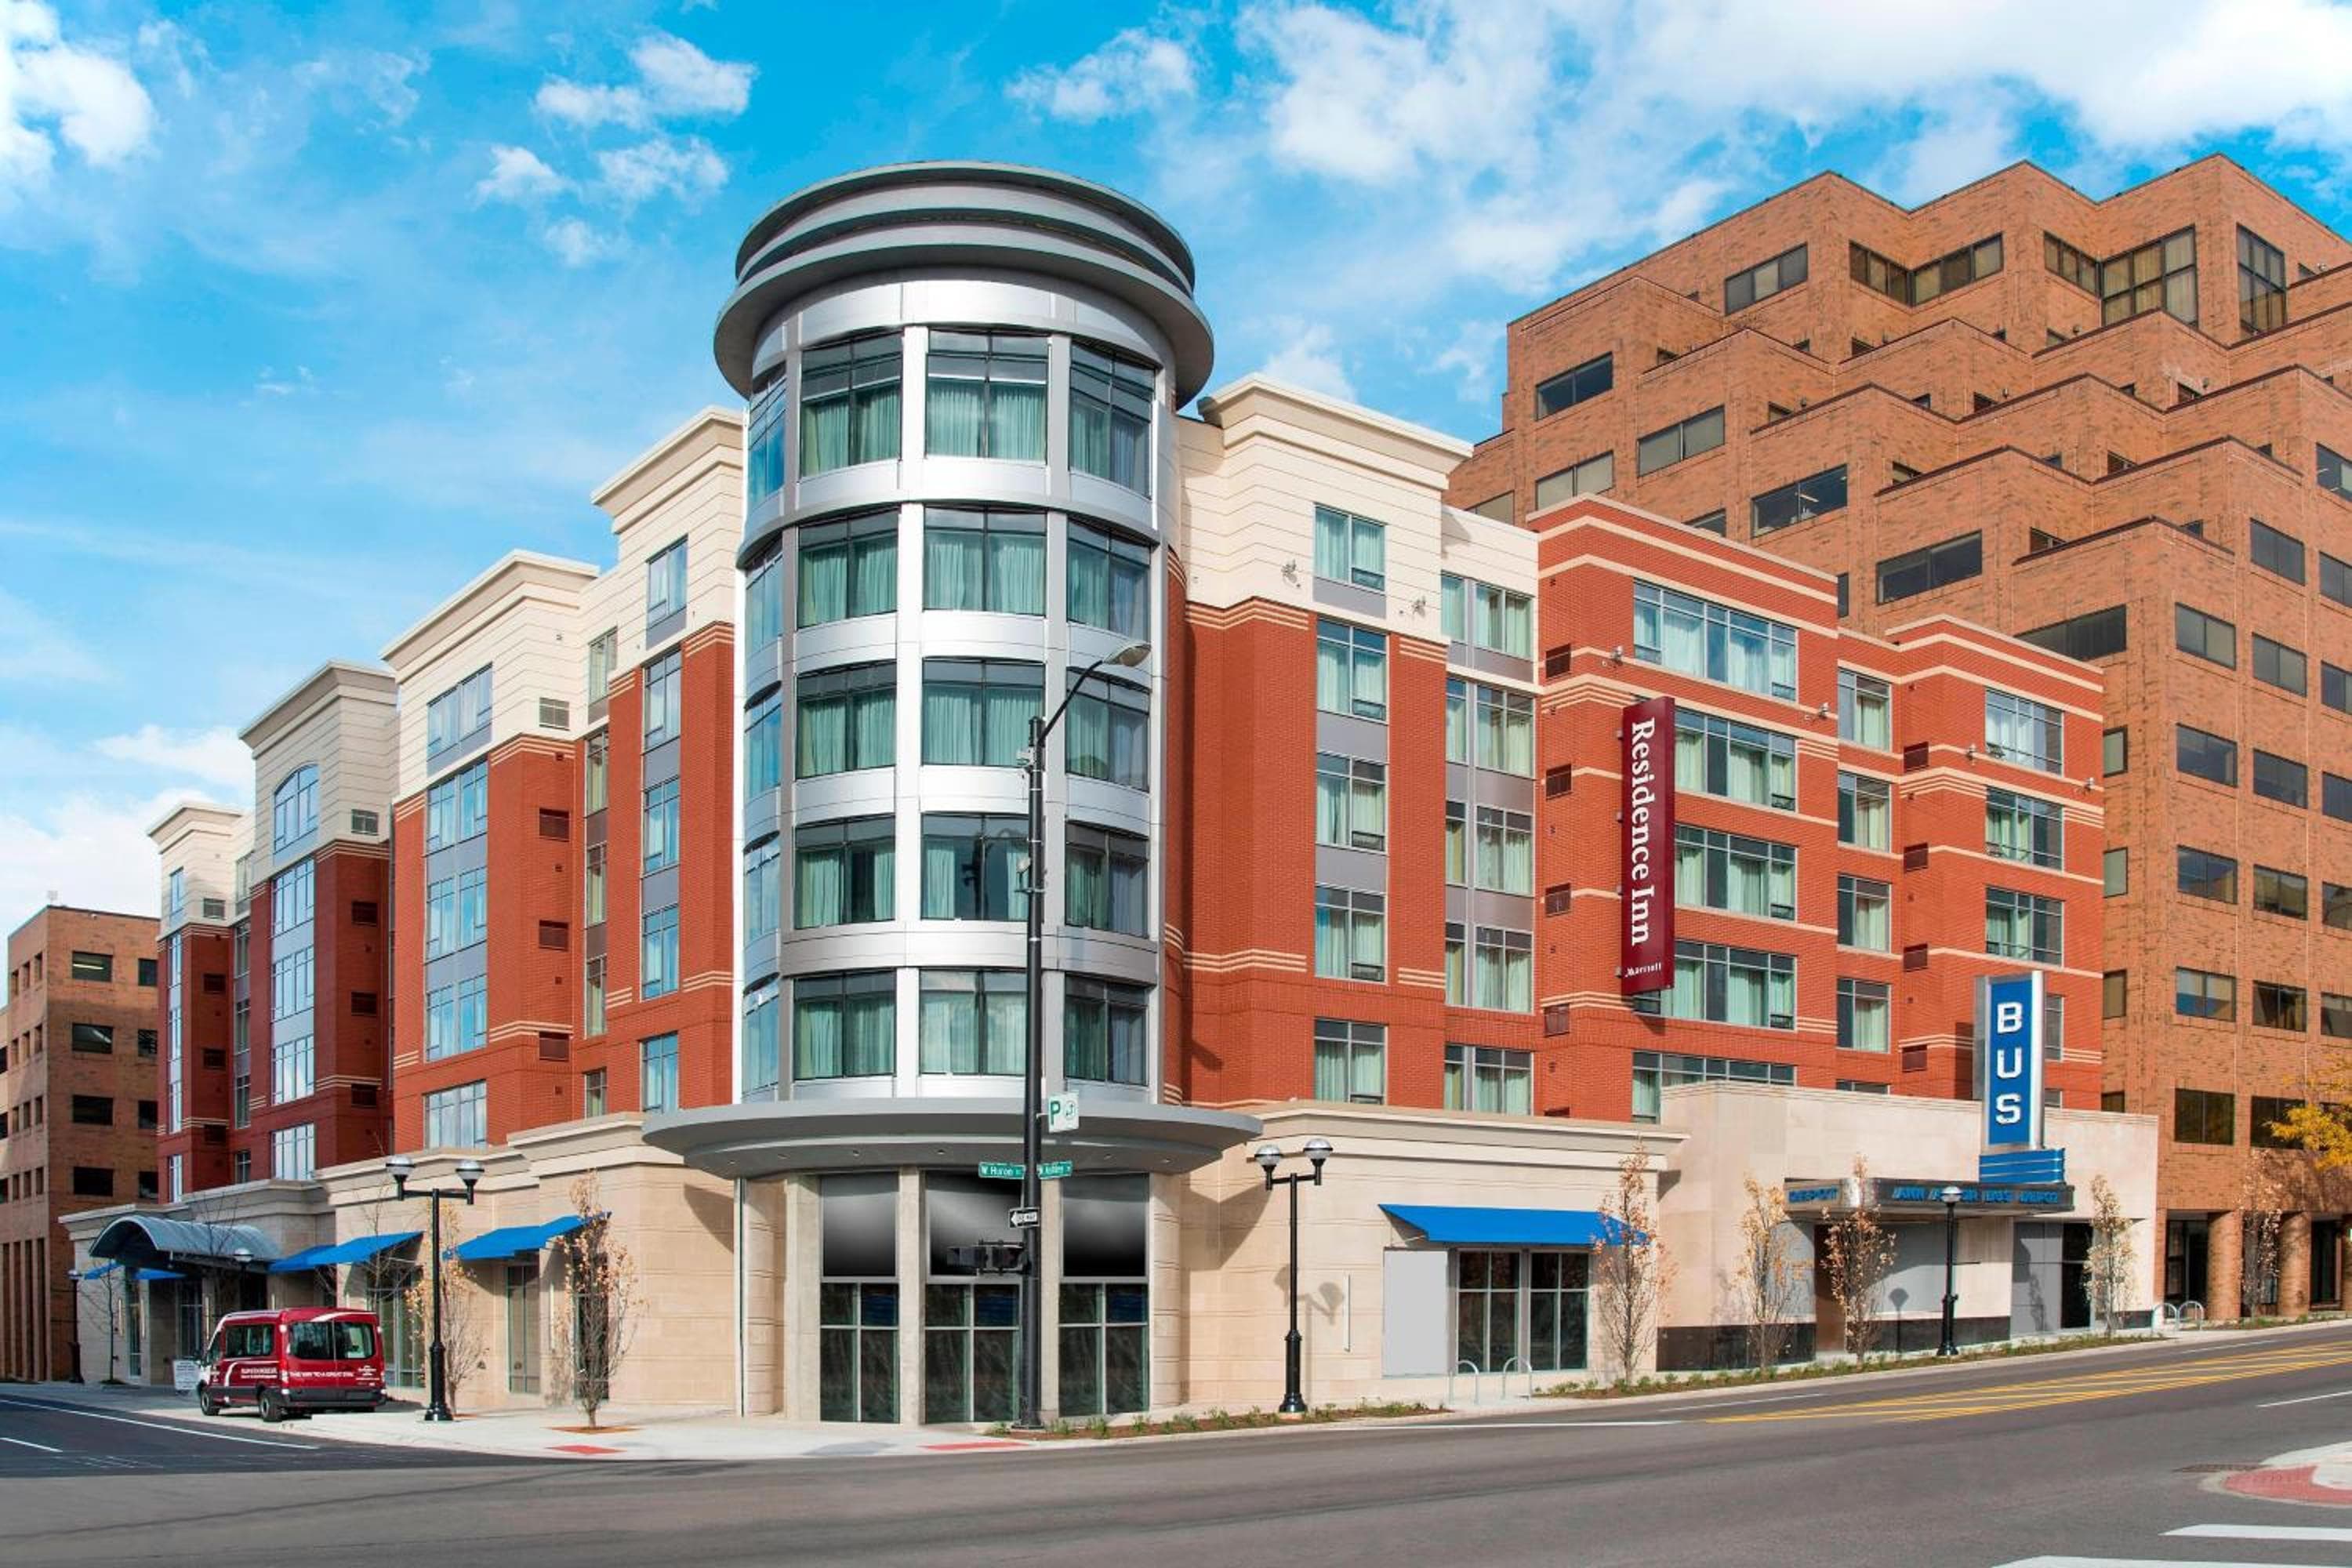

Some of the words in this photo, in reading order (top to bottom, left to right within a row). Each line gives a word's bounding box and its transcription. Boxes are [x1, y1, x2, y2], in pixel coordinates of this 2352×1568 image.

[1632, 717, 1655, 880] Residence
[1632, 885, 1655, 946] Inn
[1995, 1001, 2023, 1125] BUS
[1051, 1101, 1061, 1126] P
[990, 1166, 1014, 1175] Huron
